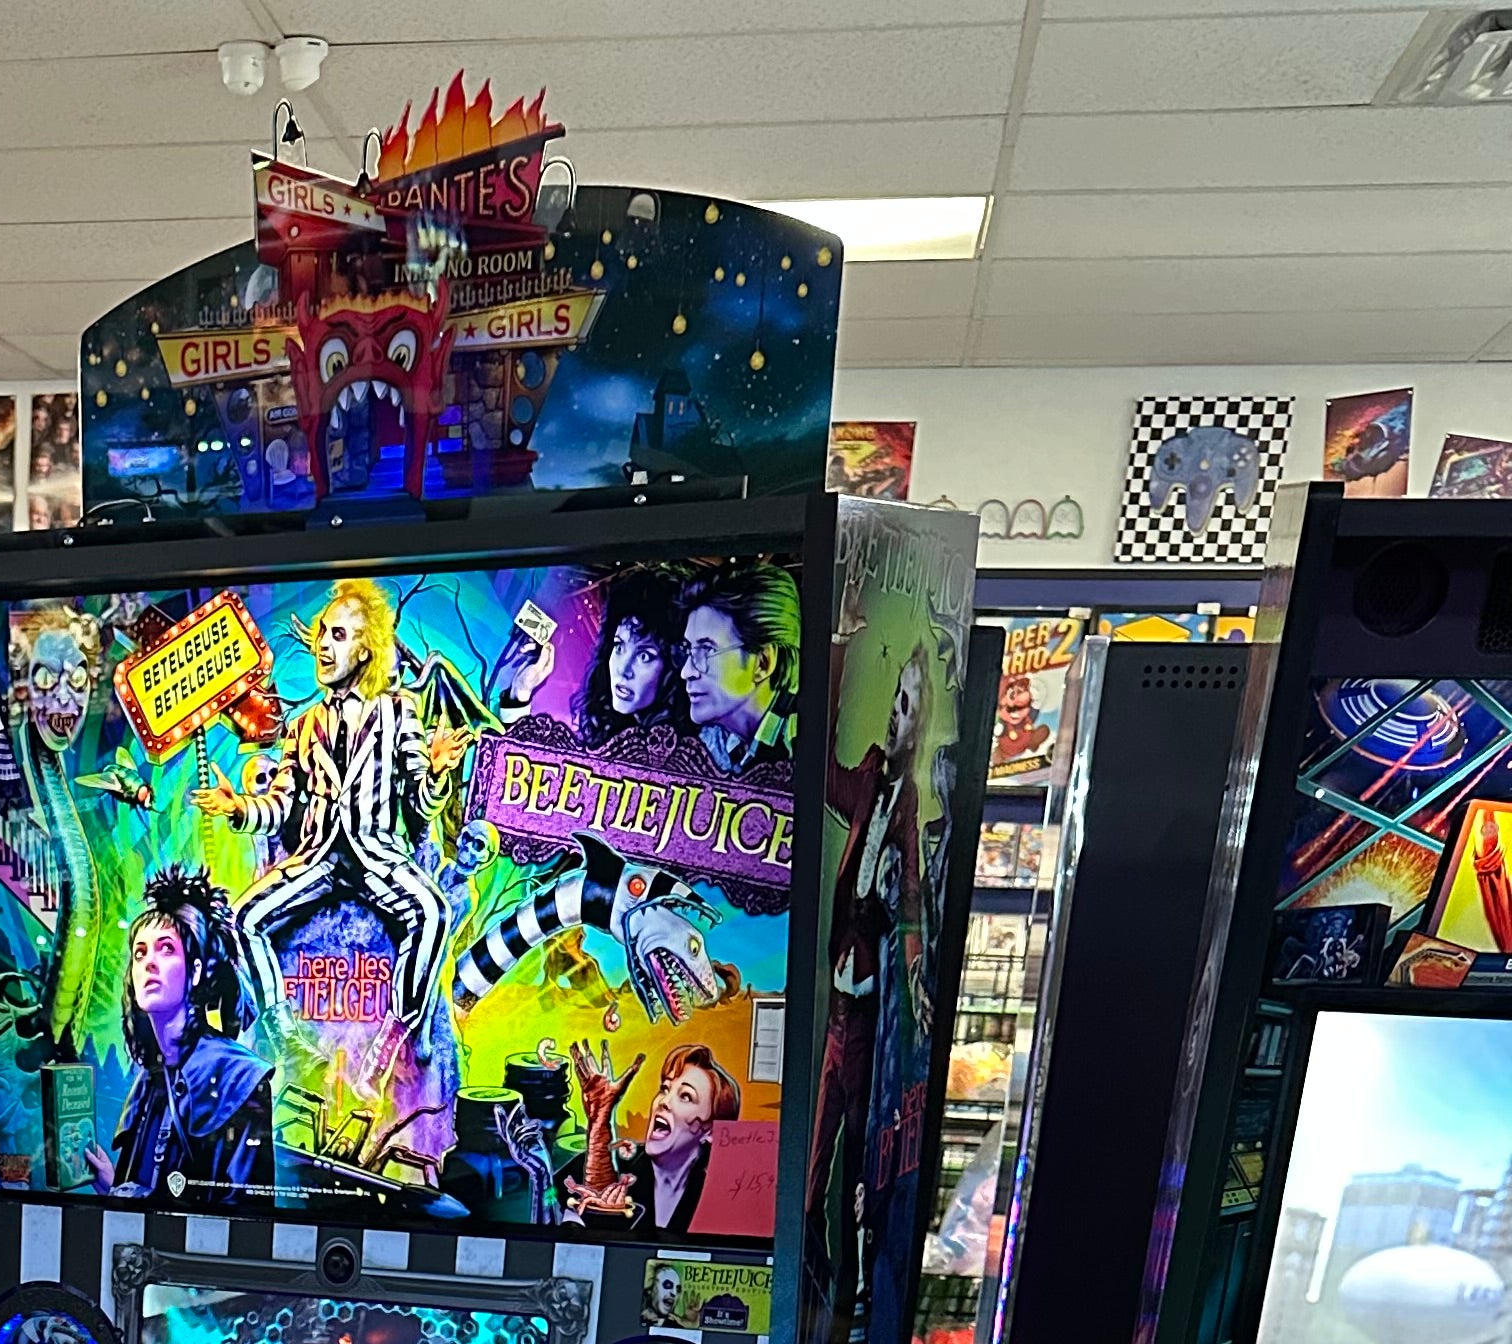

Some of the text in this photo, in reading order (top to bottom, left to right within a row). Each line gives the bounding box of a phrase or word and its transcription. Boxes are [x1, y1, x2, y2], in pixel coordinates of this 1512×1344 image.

[268, 175, 336, 216] GIRLS
[387, 156, 531, 217] DANTE'S
[477, 249, 533, 276] ROOM
[488, 303, 572, 340] GIRLS
[180, 338, 271, 378] GIRLS
[142, 615, 230, 694] BETELGEUSE
[1048, 618, 1081, 665] 2
[153, 639, 242, 720] BETELGEUSE
[503, 753, 794, 868] BEETLEJUICE
[298, 950, 391, 981] here lies
[283, 977, 391, 1022] ETELGEU
